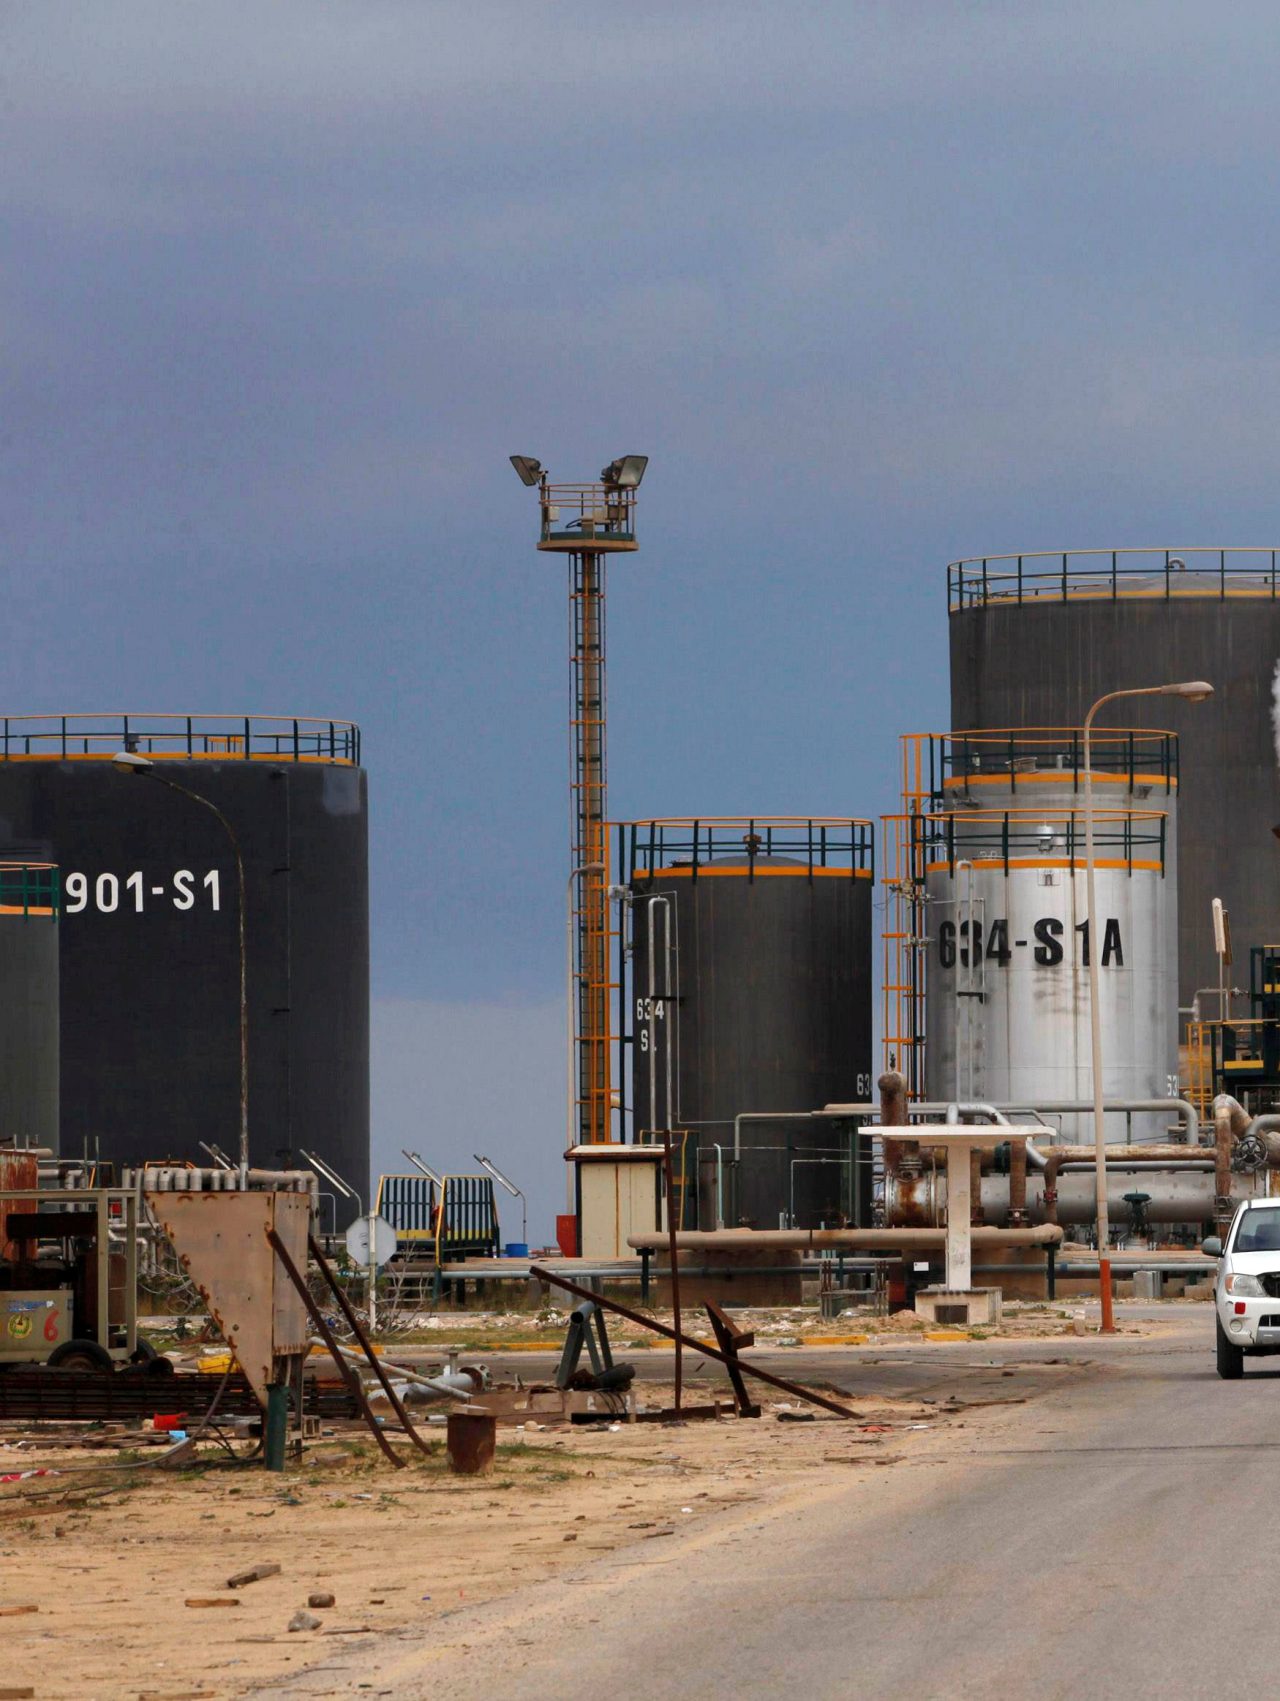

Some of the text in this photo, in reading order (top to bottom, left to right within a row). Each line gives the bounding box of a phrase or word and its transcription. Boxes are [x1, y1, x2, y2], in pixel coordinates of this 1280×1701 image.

[65, 869, 220, 914] 901-S1
[939, 917, 1124, 969] 634-S1A
[636, 998, 665, 1020] 634
[43, 1309, 59, 1342] 6
